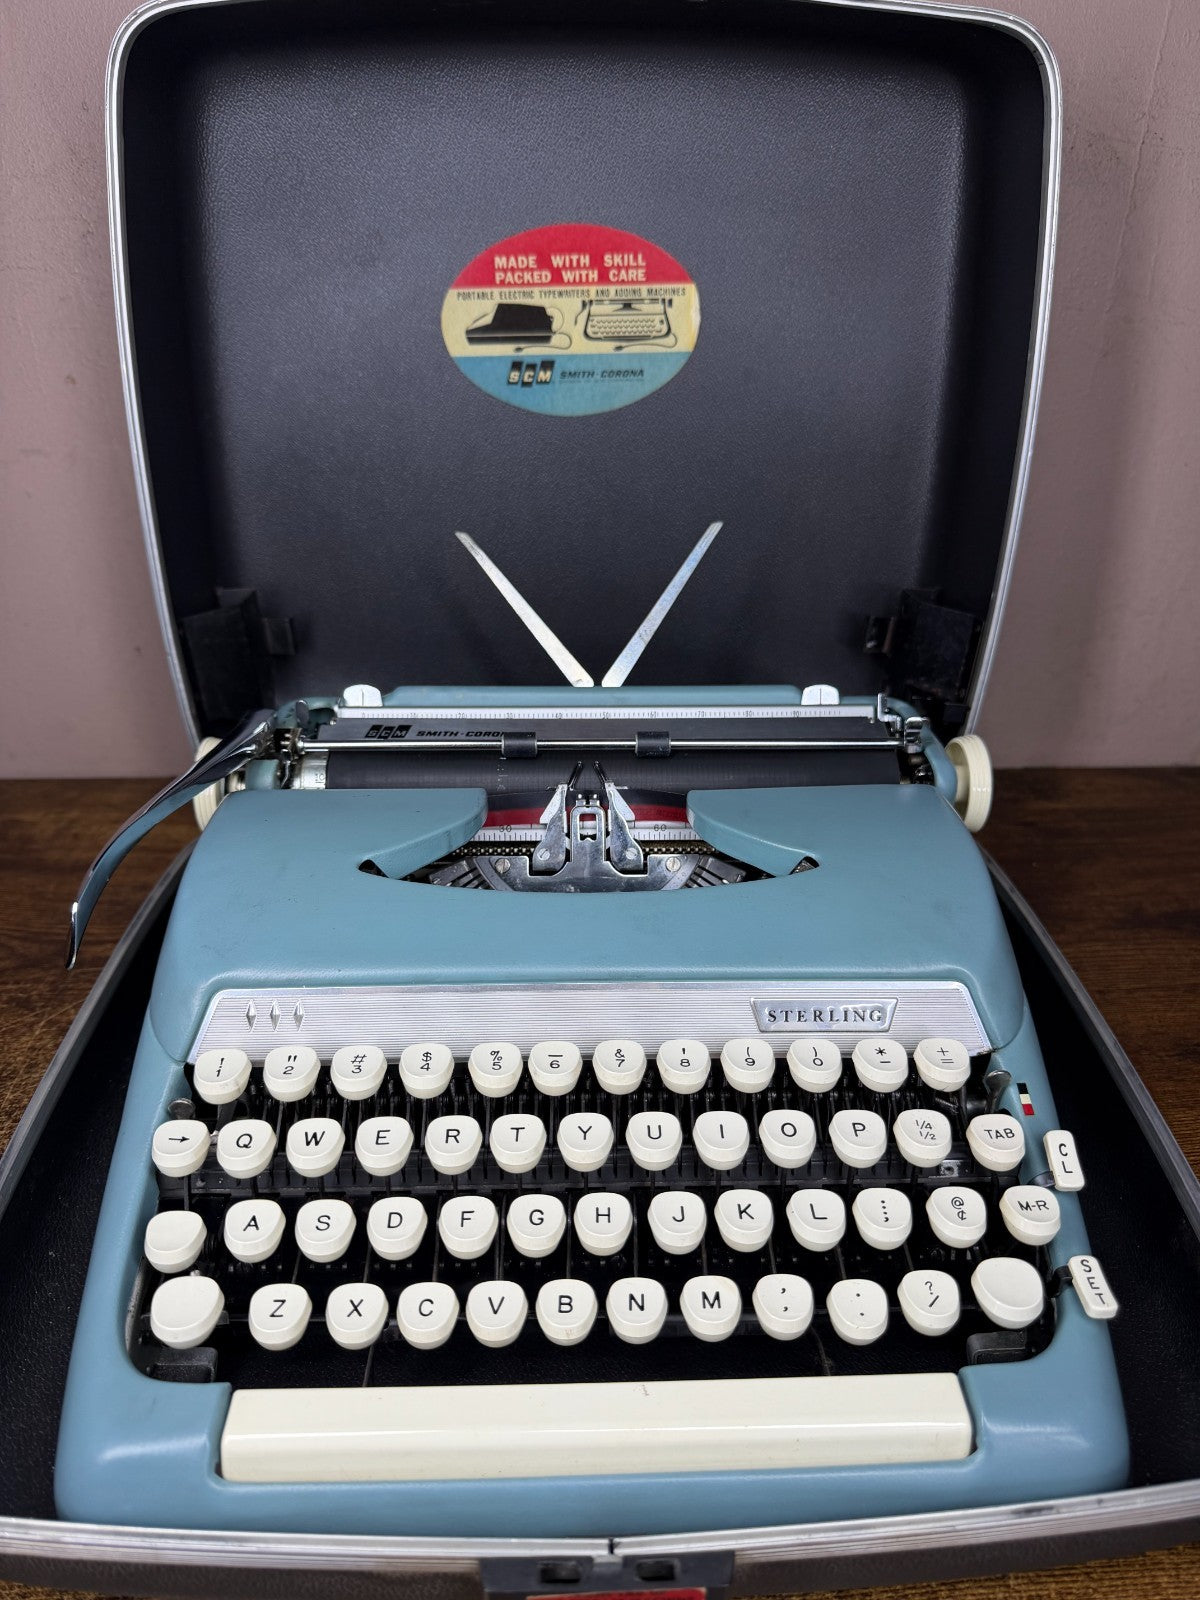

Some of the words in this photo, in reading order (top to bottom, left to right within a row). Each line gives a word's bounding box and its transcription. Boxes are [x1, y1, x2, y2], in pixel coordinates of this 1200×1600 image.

[494, 255, 537, 269] MADE
[551, 254, 590, 268] WITH
[604, 253, 646, 267] SKILL
[495, 270, 552, 285] PACKED
[561, 270, 599, 283] WITH
[609, 269, 646, 282] CARE
[457, 291, 494, 301] PORTABLE
[500, 290, 535, 300] ELECTRIC
[539, 289, 590, 299] TYPEWRITERS
[595, 288, 610, 298] AND
[615, 288, 641, 298] ADDING
[647, 287, 686, 297] MACHINES
[508, 369, 553, 384] SCM
[364, 727, 410, 739] SCM
[499, 824, 513, 833] 30
[653, 823, 667, 832] 60
[767, 1009, 883, 1023] STERLING
[351, 1055, 367, 1064] #
[422, 1052, 432, 1062] $
[490, 1051, 502, 1061] %
[615, 1049, 625, 1058] &
[352, 1065, 361, 1073] 3
[420, 1063, 430, 1071] 4
[492, 1062, 501, 1070] 5
[550, 1060, 560, 1068] 6
[616, 1059, 625, 1067] 7
[680, 1059, 690, 1067] 8
[745, 1058, 755, 1066] 9
[283, 1066, 294, 1074] 2
[445, 1129, 460, 1143] R
[510, 1127, 525, 1142] T
[578, 1126, 592, 1140] Y
[647, 1125, 661, 1139] U
[781, 1123, 797, 1137] O
[852, 1123, 866, 1137] P
[984, 1128, 1015, 1139] TAB
[236, 1134, 252, 1148] Q
[305, 1131, 325, 1146] W
[375, 1130, 390, 1145] E
[951, 1197, 964, 1211] @
[1018, 1200, 1049, 1211] M-R
[529, 1209, 544, 1225] G
[596, 1207, 610, 1223] H
[672, 1206, 684, 1222] J
[737, 1204, 754, 1219] K
[810, 1204, 828, 1220] L
[243, 1215, 259, 1231] A
[316, 1215, 330, 1231] S
[387, 1212, 402, 1228] D
[461, 1211, 474, 1227] F
[488, 1297, 504, 1314] V
[558, 1295, 573, 1313] B
[629, 1294, 644, 1311] N
[702, 1291, 721, 1309] M
[270, 1299, 286, 1317] Z
[347, 1299, 363, 1317] X
[419, 1299, 433, 1316] C
